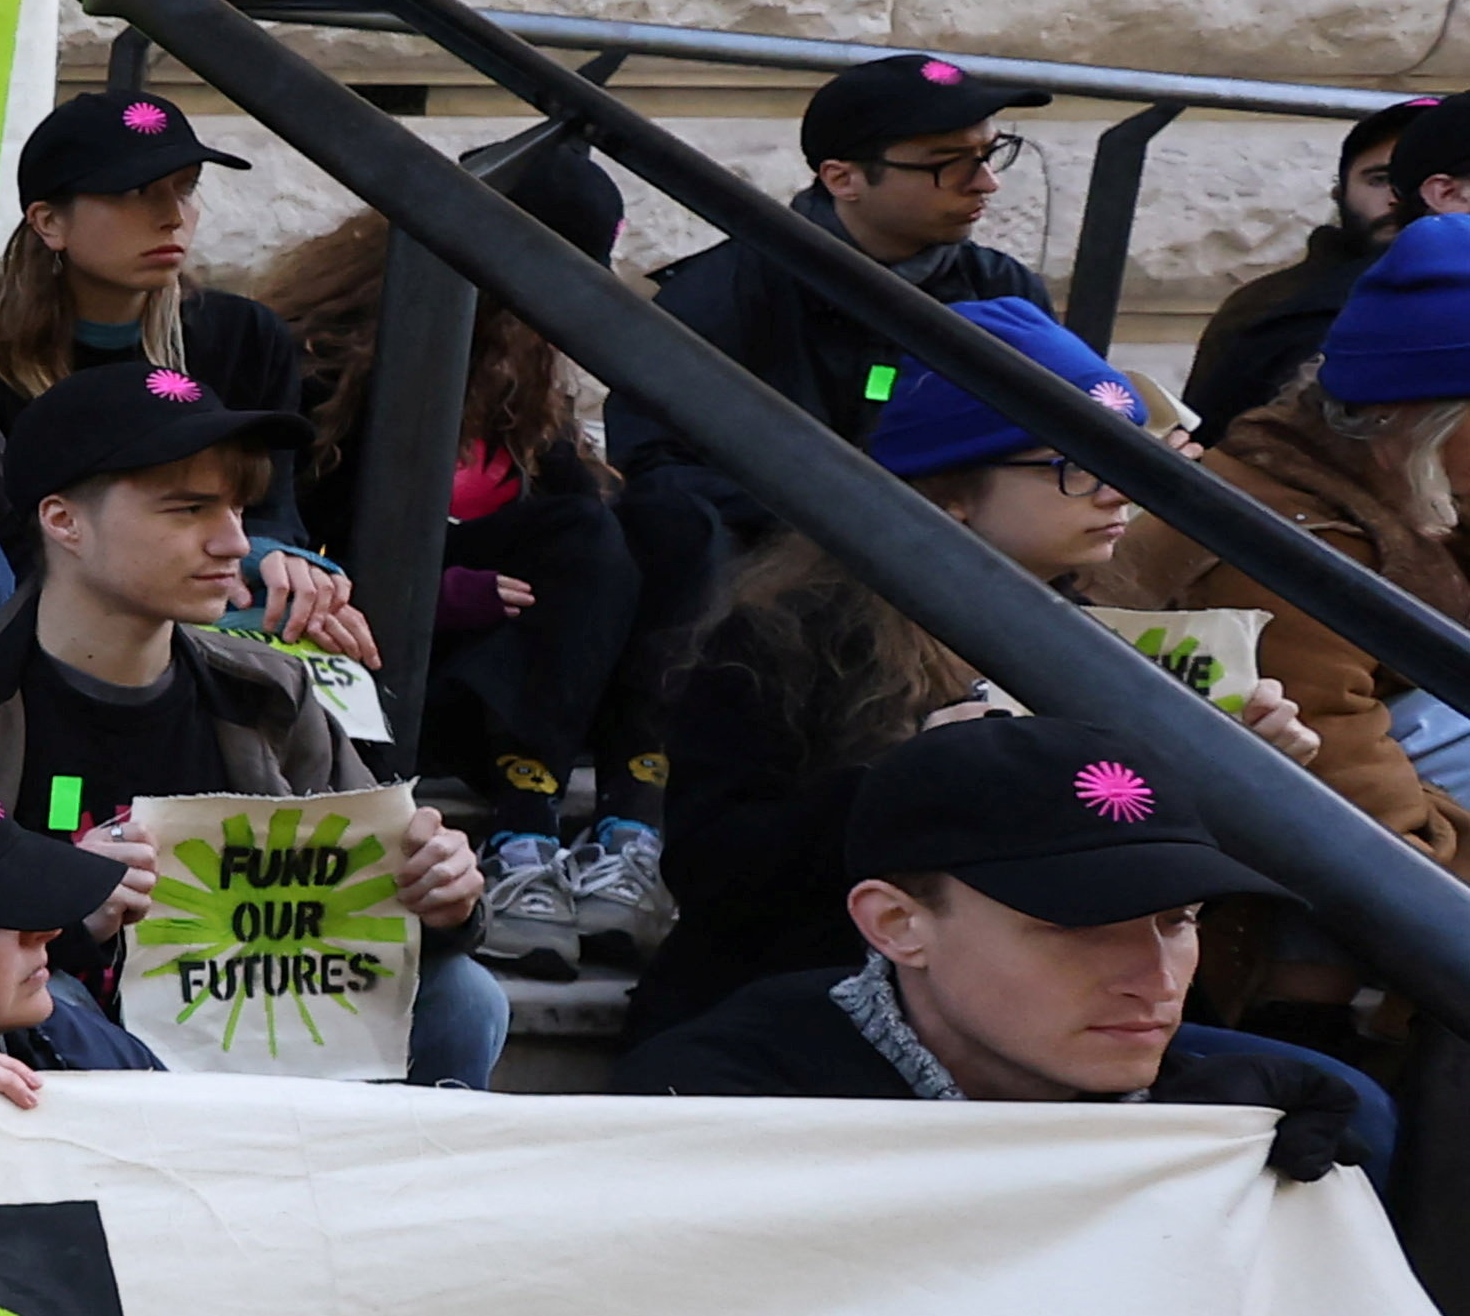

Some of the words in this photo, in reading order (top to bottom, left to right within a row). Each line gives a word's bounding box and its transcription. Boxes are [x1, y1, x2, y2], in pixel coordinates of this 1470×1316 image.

[220, 846, 349, 889] FUND
[232, 901, 325, 942] OUR
[178, 953, 383, 1003] FUTURES
